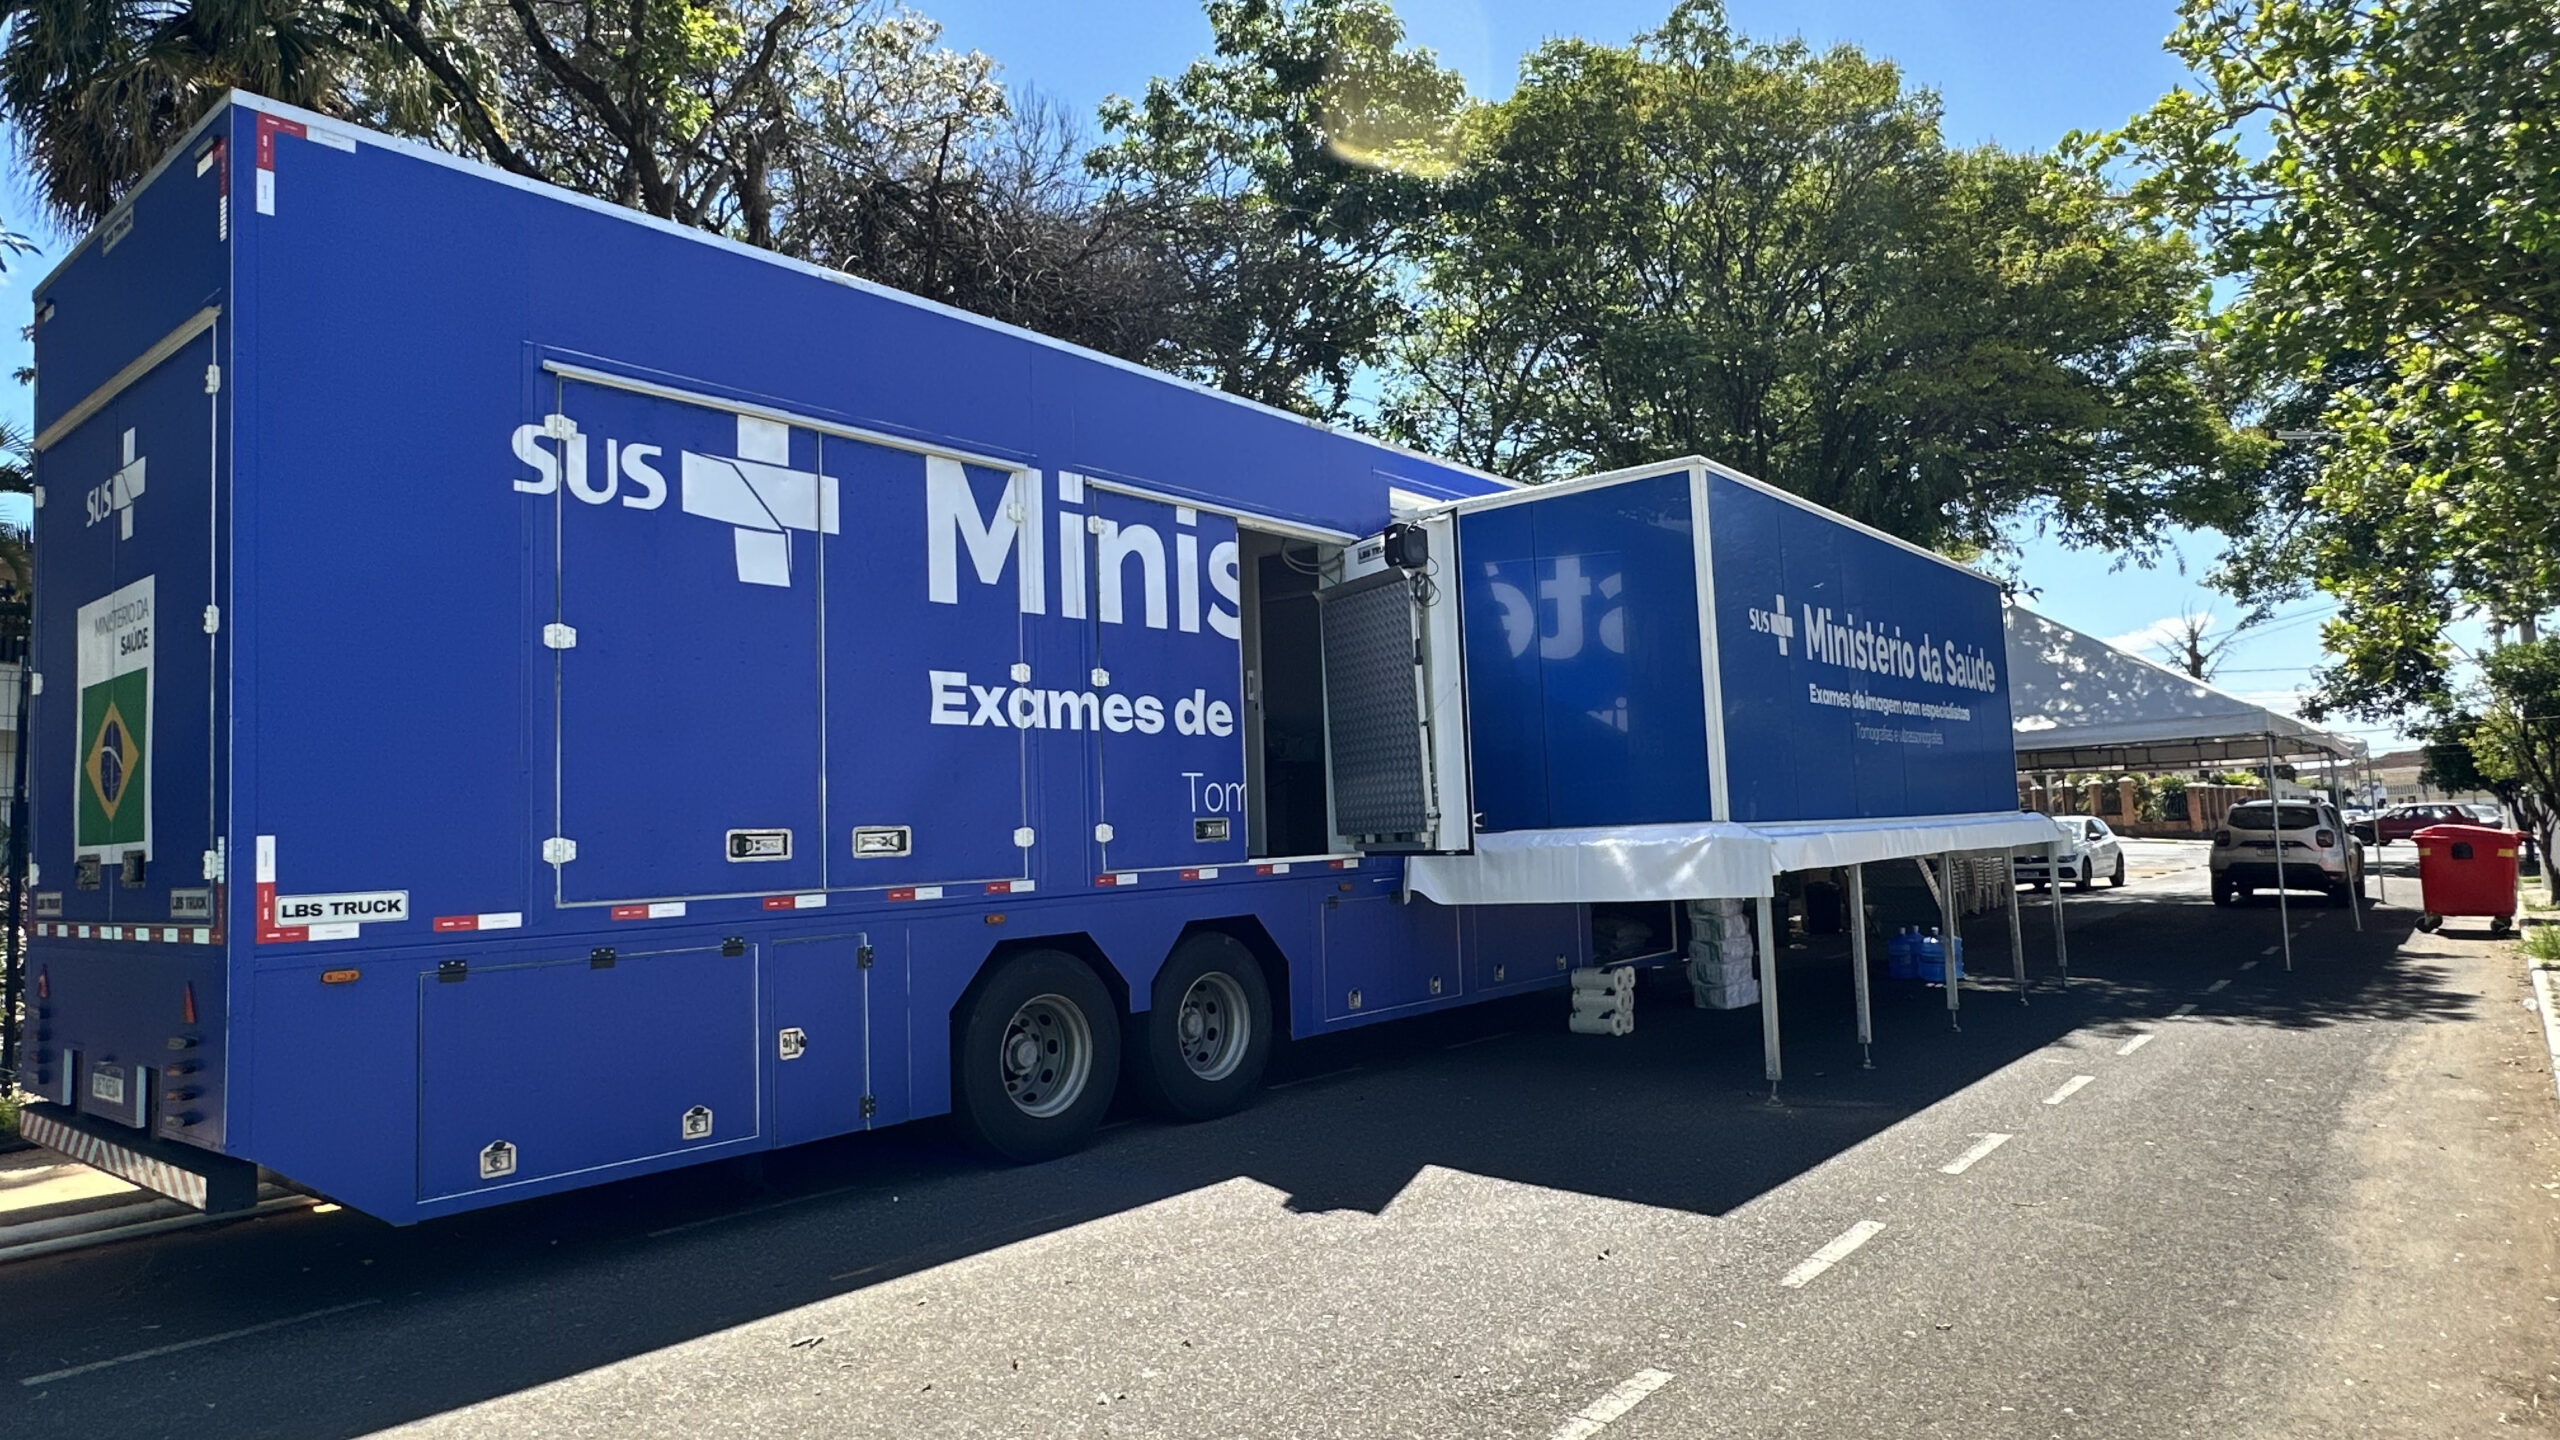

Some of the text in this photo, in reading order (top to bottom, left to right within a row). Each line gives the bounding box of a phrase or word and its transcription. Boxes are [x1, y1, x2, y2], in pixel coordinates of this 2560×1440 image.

[512, 424, 667, 511] SUS
[86, 478, 112, 528] SUS
[926, 454, 1241, 640] Minis
[136, 596, 149, 621] DA
[121, 626, 149, 656] SAÚDE
[1749, 603, 1996, 693] SUS Ministério da Saúde
[929, 670, 1234, 738] Exames de
[1809, 683, 1971, 722] Exames de imagem com especialistas
[1181, 772, 1245, 813] Tom
[185, 896, 207, 910] TRUCK
[282, 904, 323, 919] LBS
[330, 899, 403, 916] TRUCK
